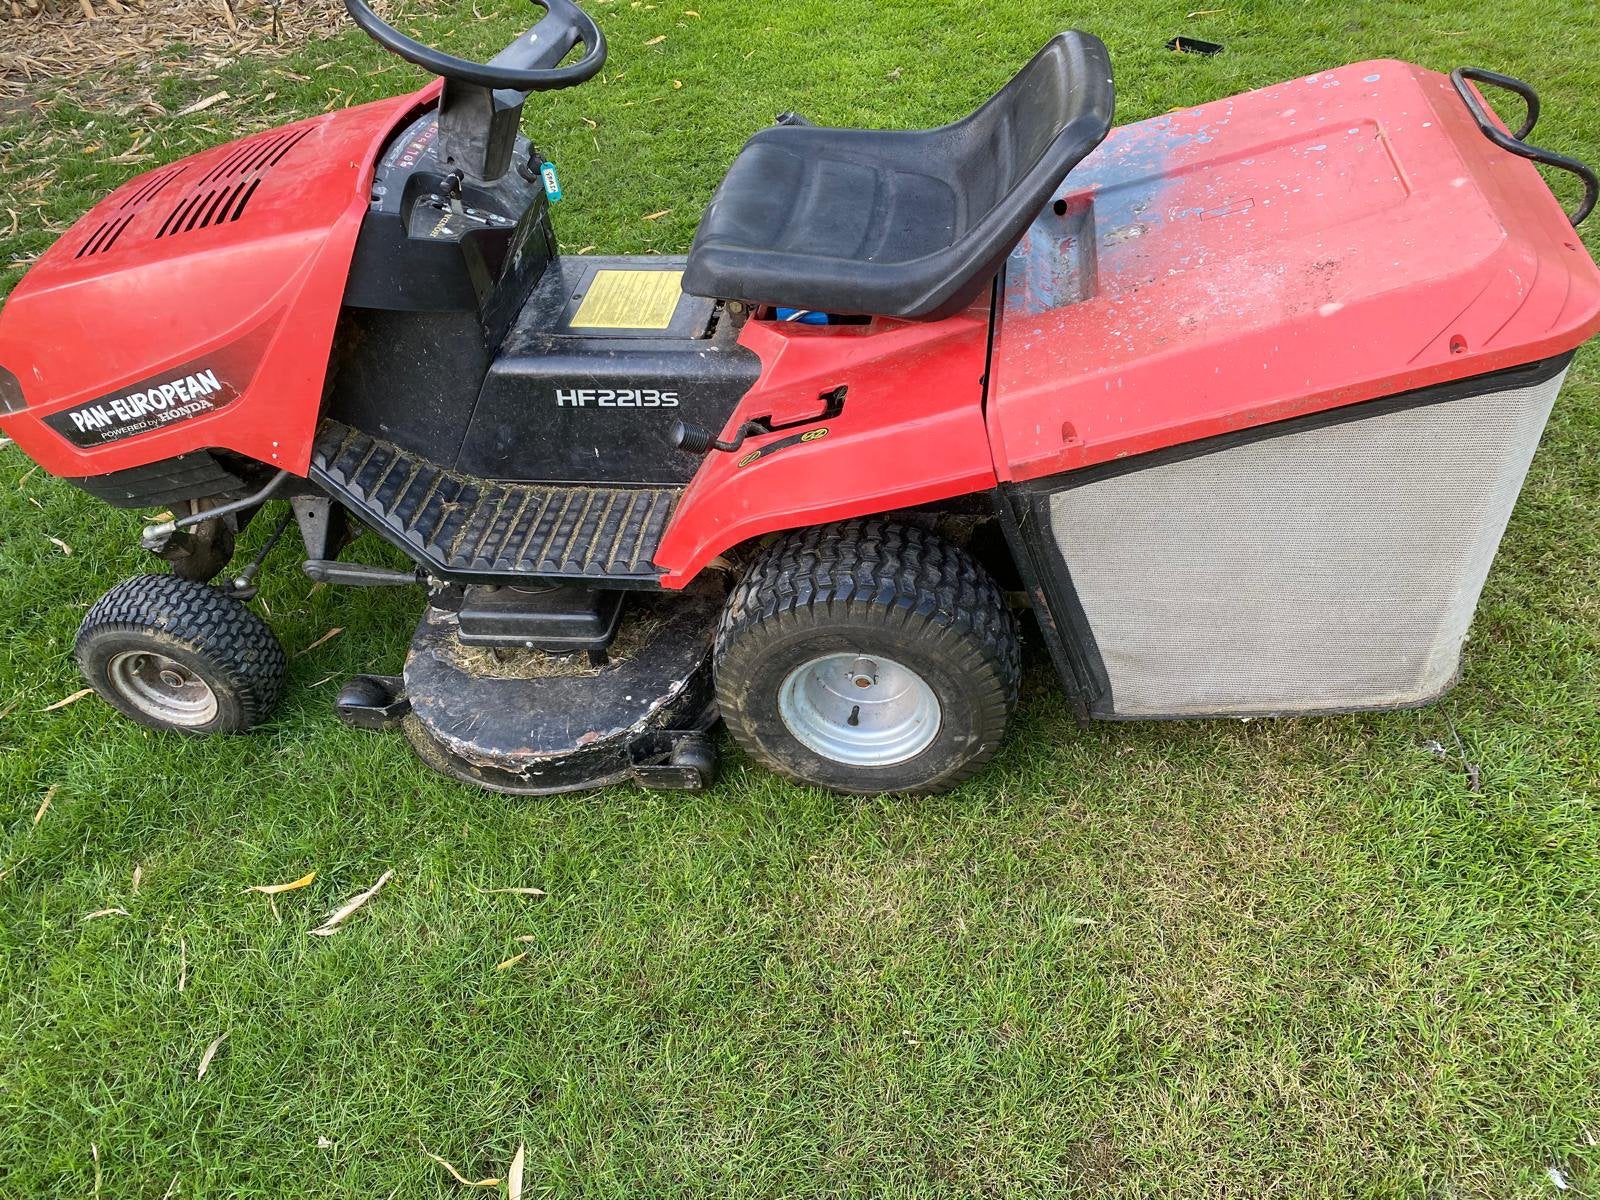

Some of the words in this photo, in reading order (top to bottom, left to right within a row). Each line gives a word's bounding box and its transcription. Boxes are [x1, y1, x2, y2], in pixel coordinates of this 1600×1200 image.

[69, 369, 223, 432] PAN-EUROPEAN
[556, 389, 679, 407] HF2213S
[100, 421, 147, 439] POWERED
[147, 418, 158, 428] by
[158, 399, 214, 422] HONDA
